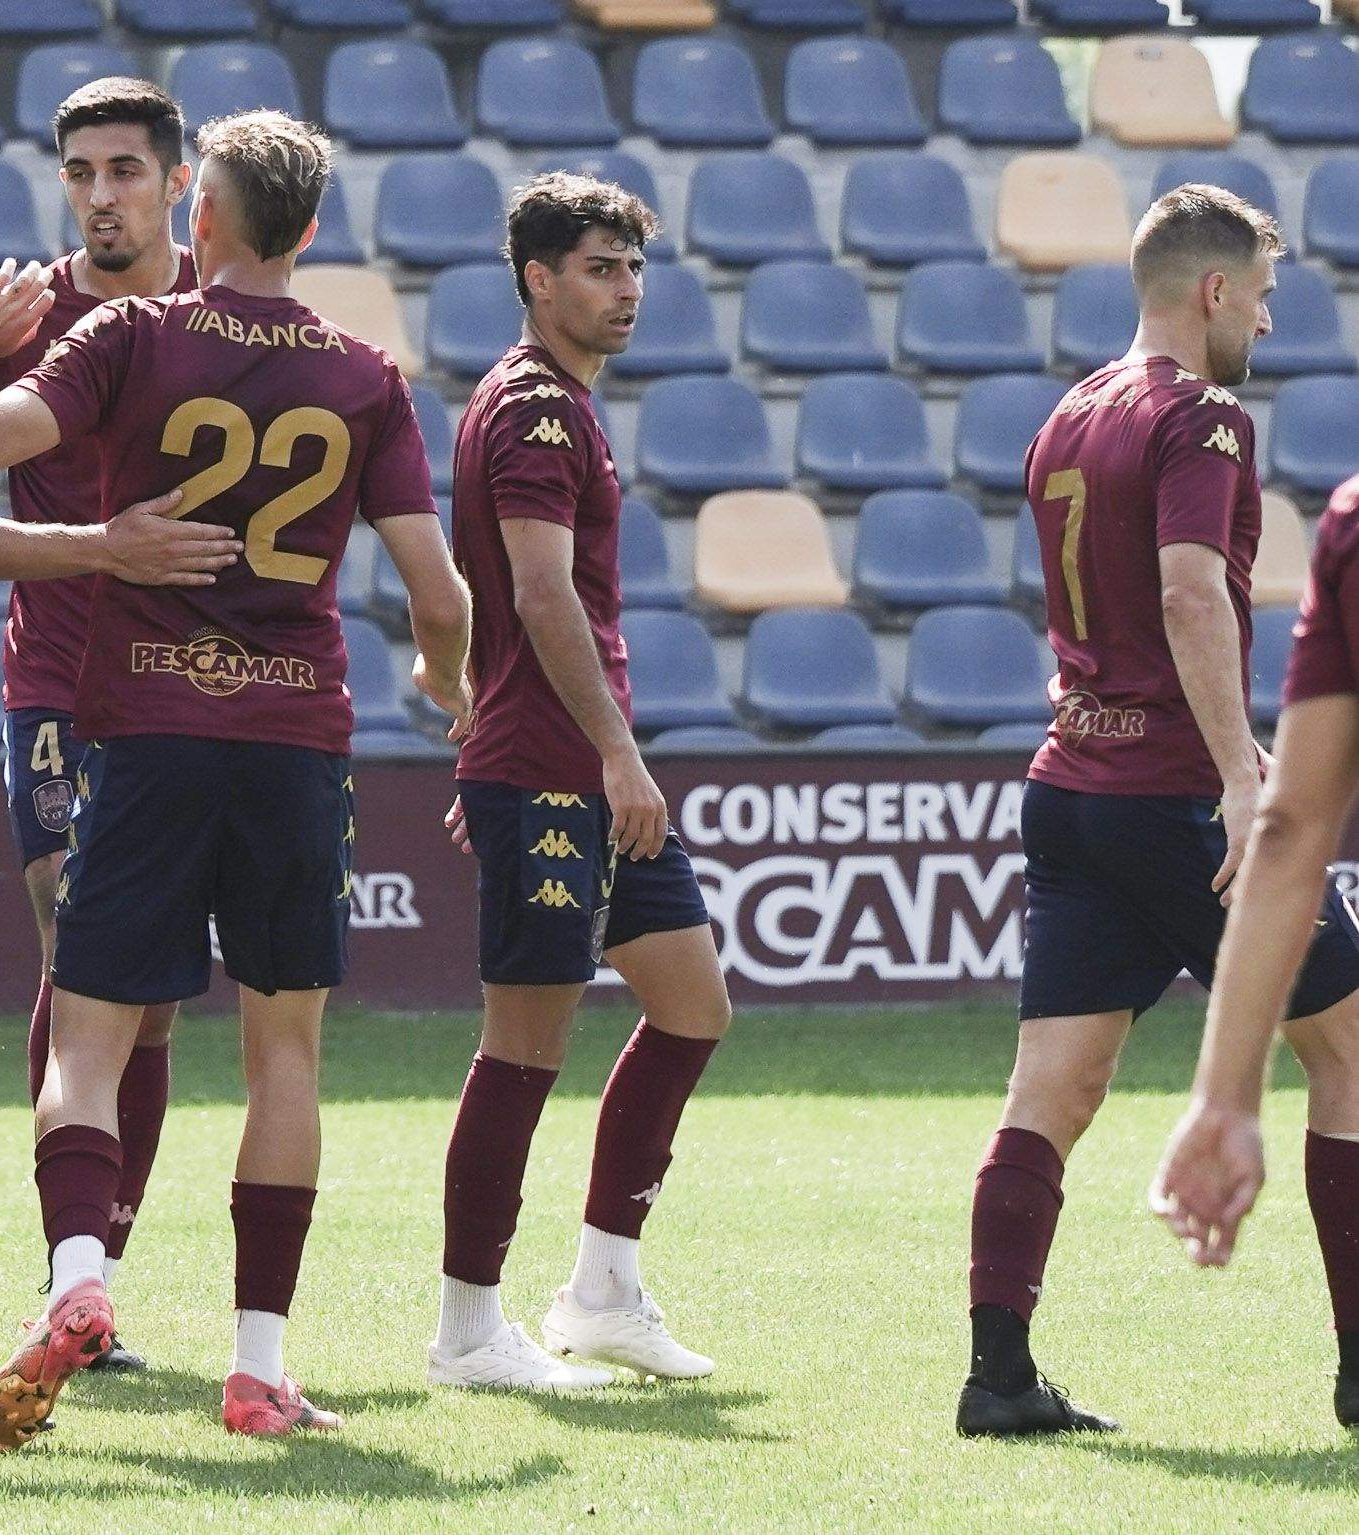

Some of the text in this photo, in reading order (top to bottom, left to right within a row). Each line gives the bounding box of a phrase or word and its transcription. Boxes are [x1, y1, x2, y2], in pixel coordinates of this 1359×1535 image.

[160, 397, 351, 585] 22
[1044, 467, 1088, 641] 7
[132, 641, 317, 690] PESCAMAR
[31, 721, 63, 776] 4
[681, 781, 1024, 845] CONSERVA
